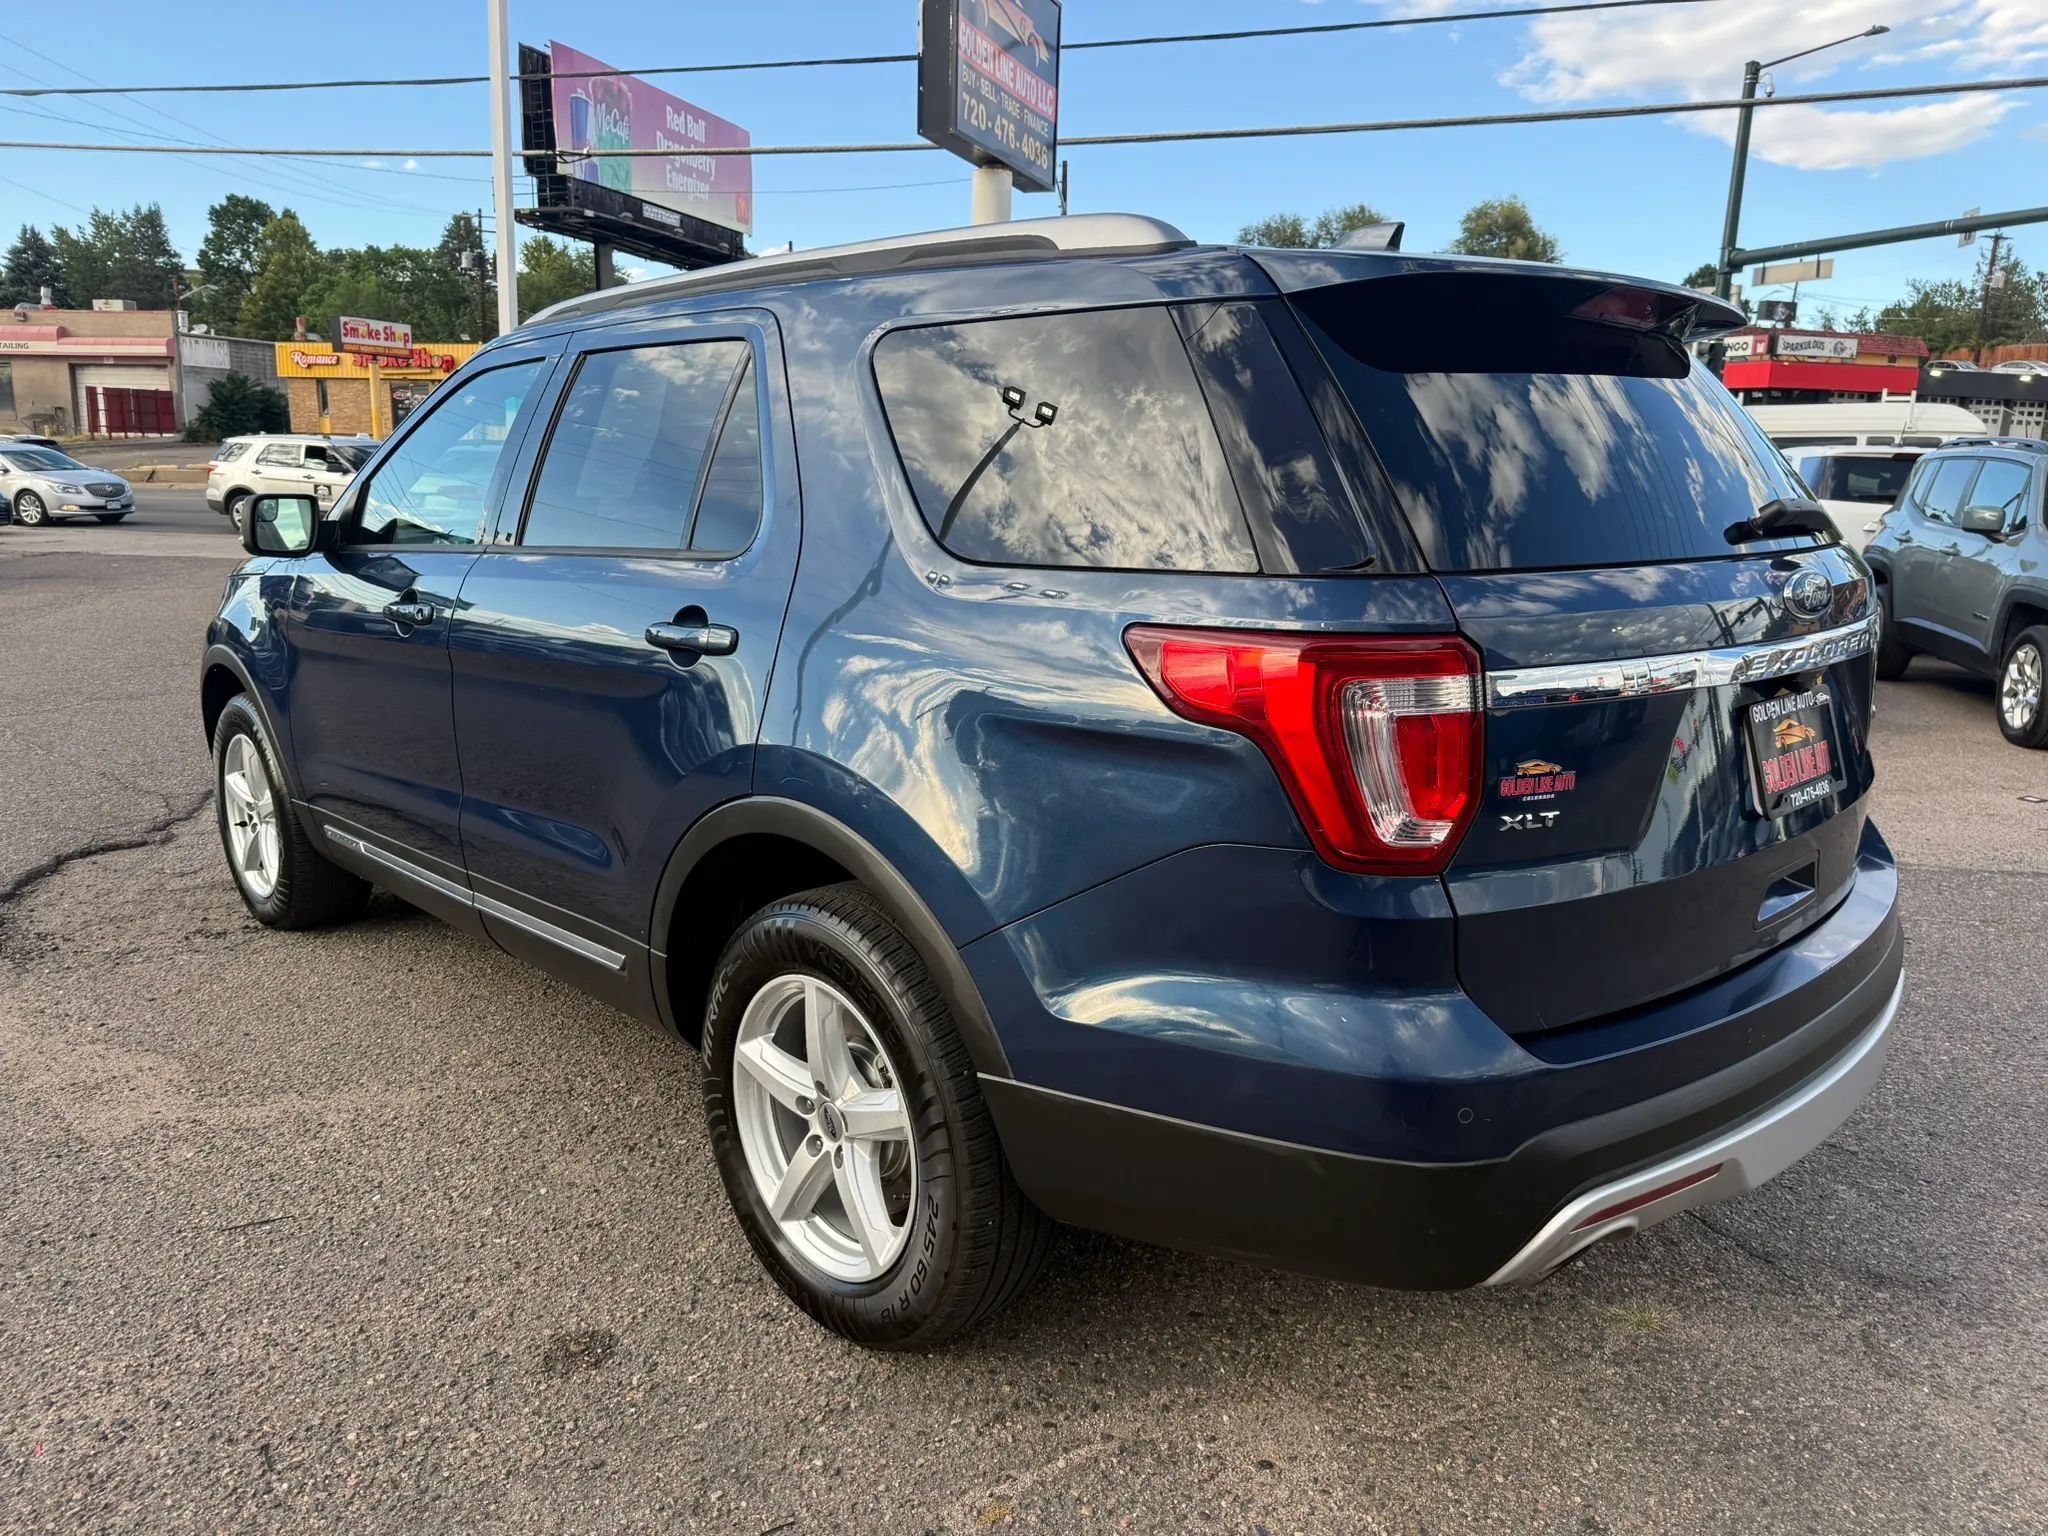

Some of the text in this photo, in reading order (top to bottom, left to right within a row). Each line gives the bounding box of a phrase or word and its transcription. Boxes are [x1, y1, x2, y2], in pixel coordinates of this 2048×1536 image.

[960, 21, 1054, 115] GOLDEN LINE AUTO LLC
[962, 64, 1049, 138] BUY SELL TRADE FINANCE
[665, 104, 706, 144] Red Bull
[665, 164, 710, 201] Energizer
[343, 320, 410, 347] Smoke Shop
[291, 351, 339, 368] Romance
[1780, 695, 1797, 715] LINE
[1797, 690, 1813, 709] AUTO
[1500, 773, 1576, 798] GOLDEN LINE AUTO
[1762, 752, 1799, 795] GOLDEN
[1522, 793, 1556, 802] COLORADO
[1499, 811, 1561, 832] XLT
